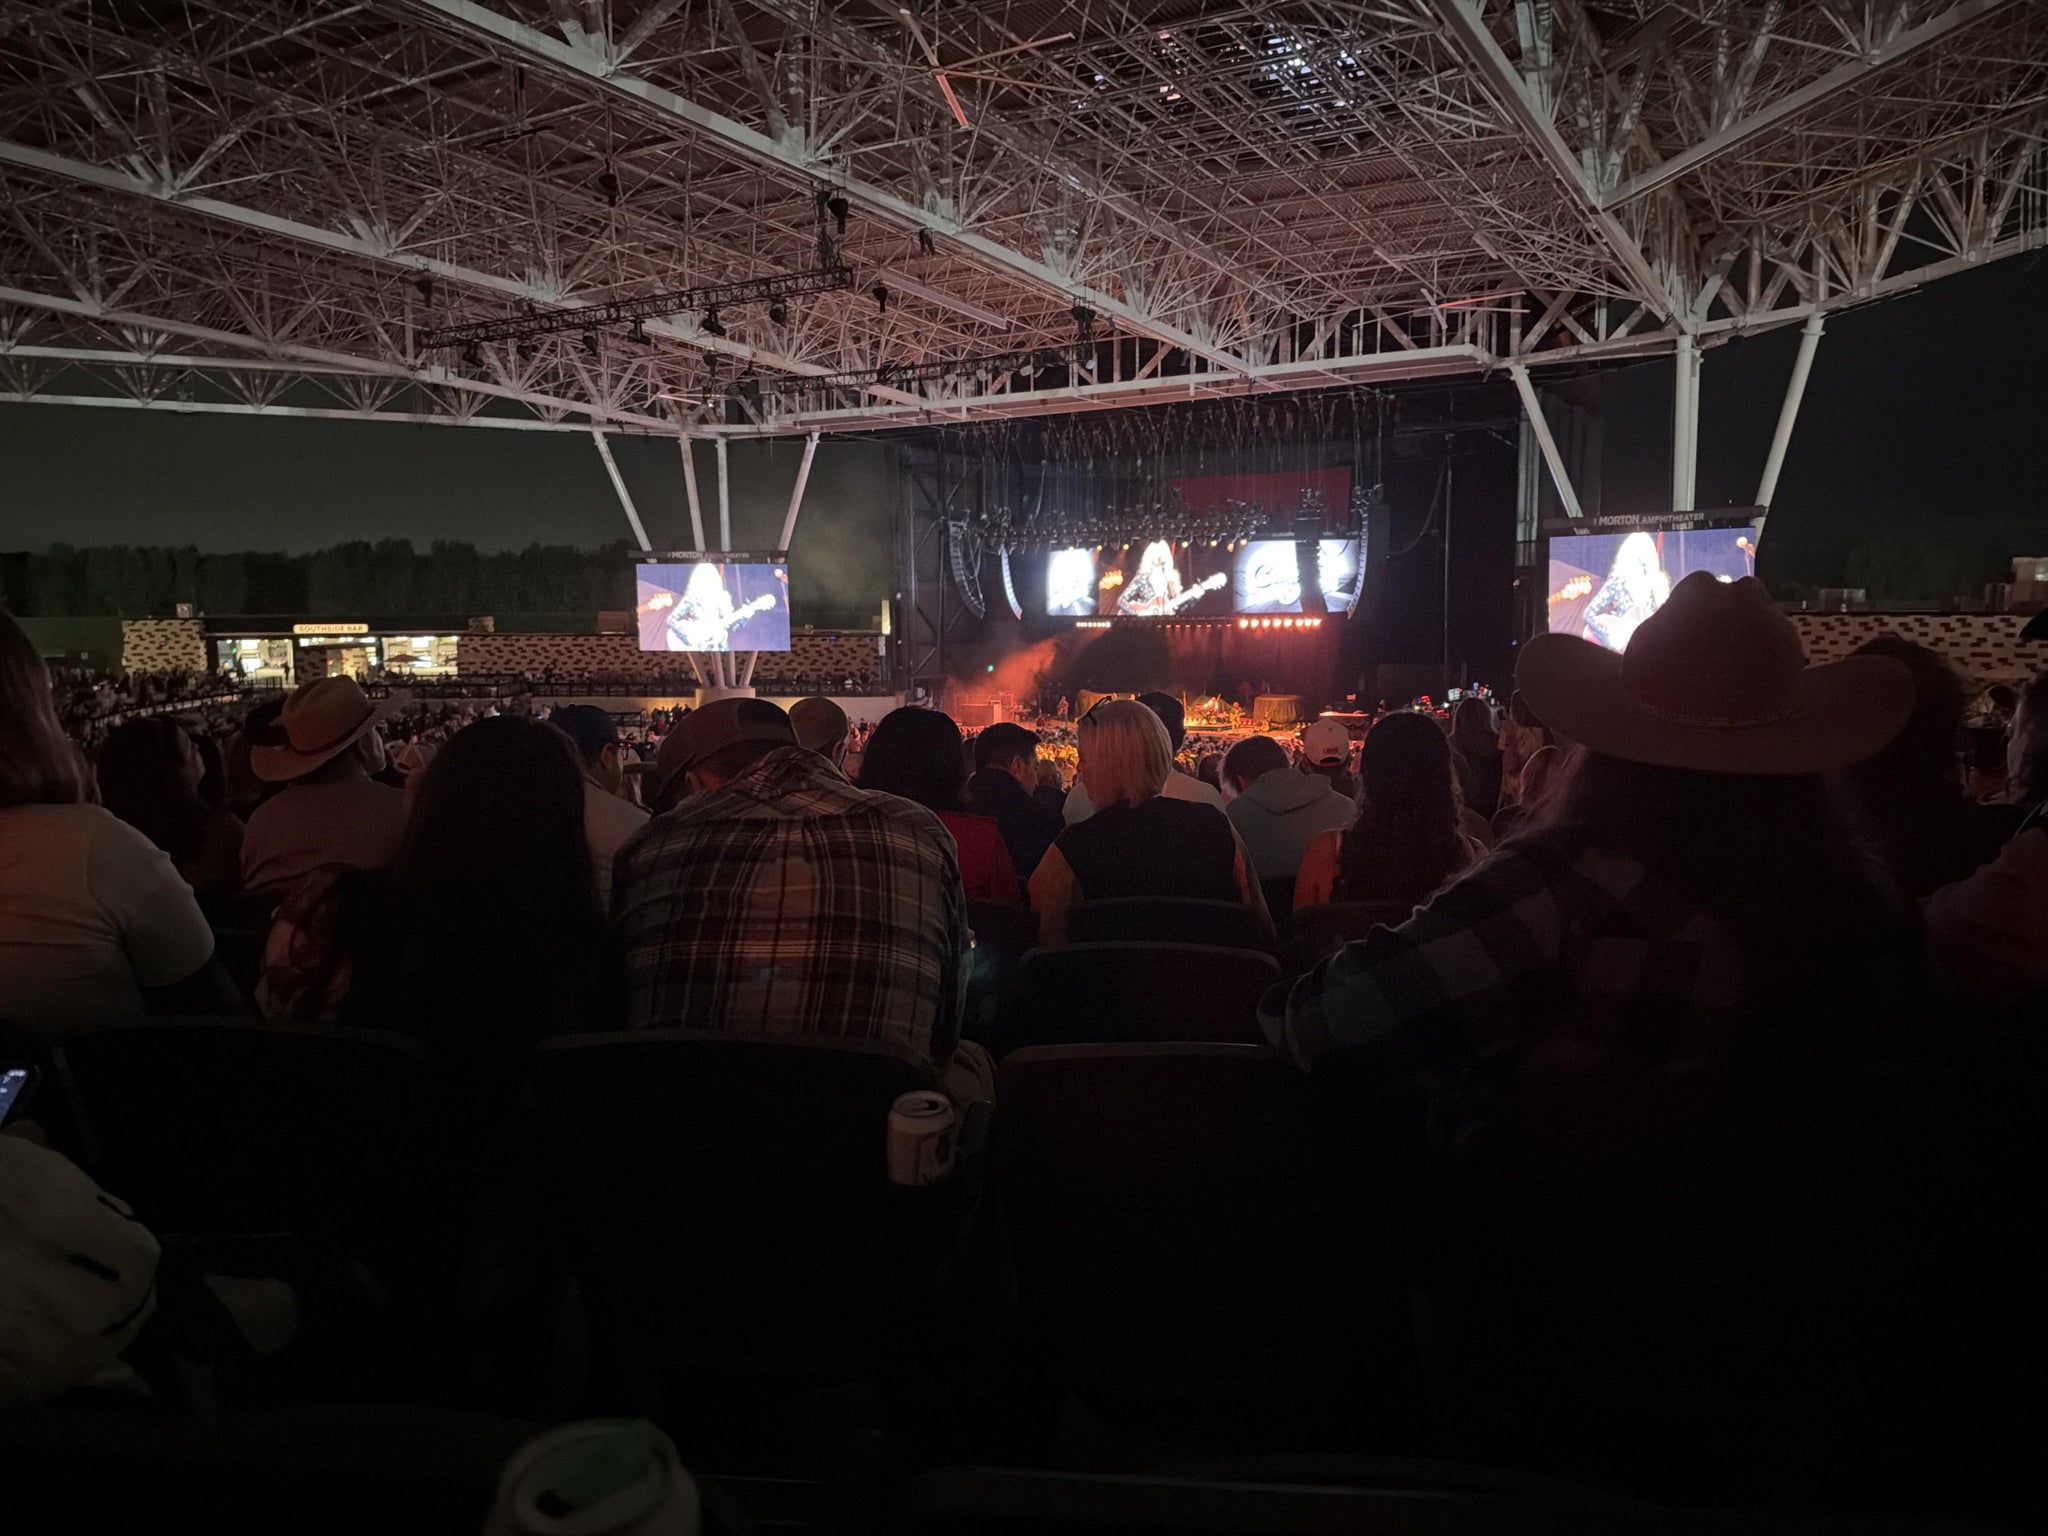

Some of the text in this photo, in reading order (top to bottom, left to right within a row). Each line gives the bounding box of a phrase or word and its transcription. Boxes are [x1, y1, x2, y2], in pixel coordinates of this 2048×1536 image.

[1599, 513, 1705, 526] MORTON AMPHITHEATER
[671, 551, 703, 559] MORTON
